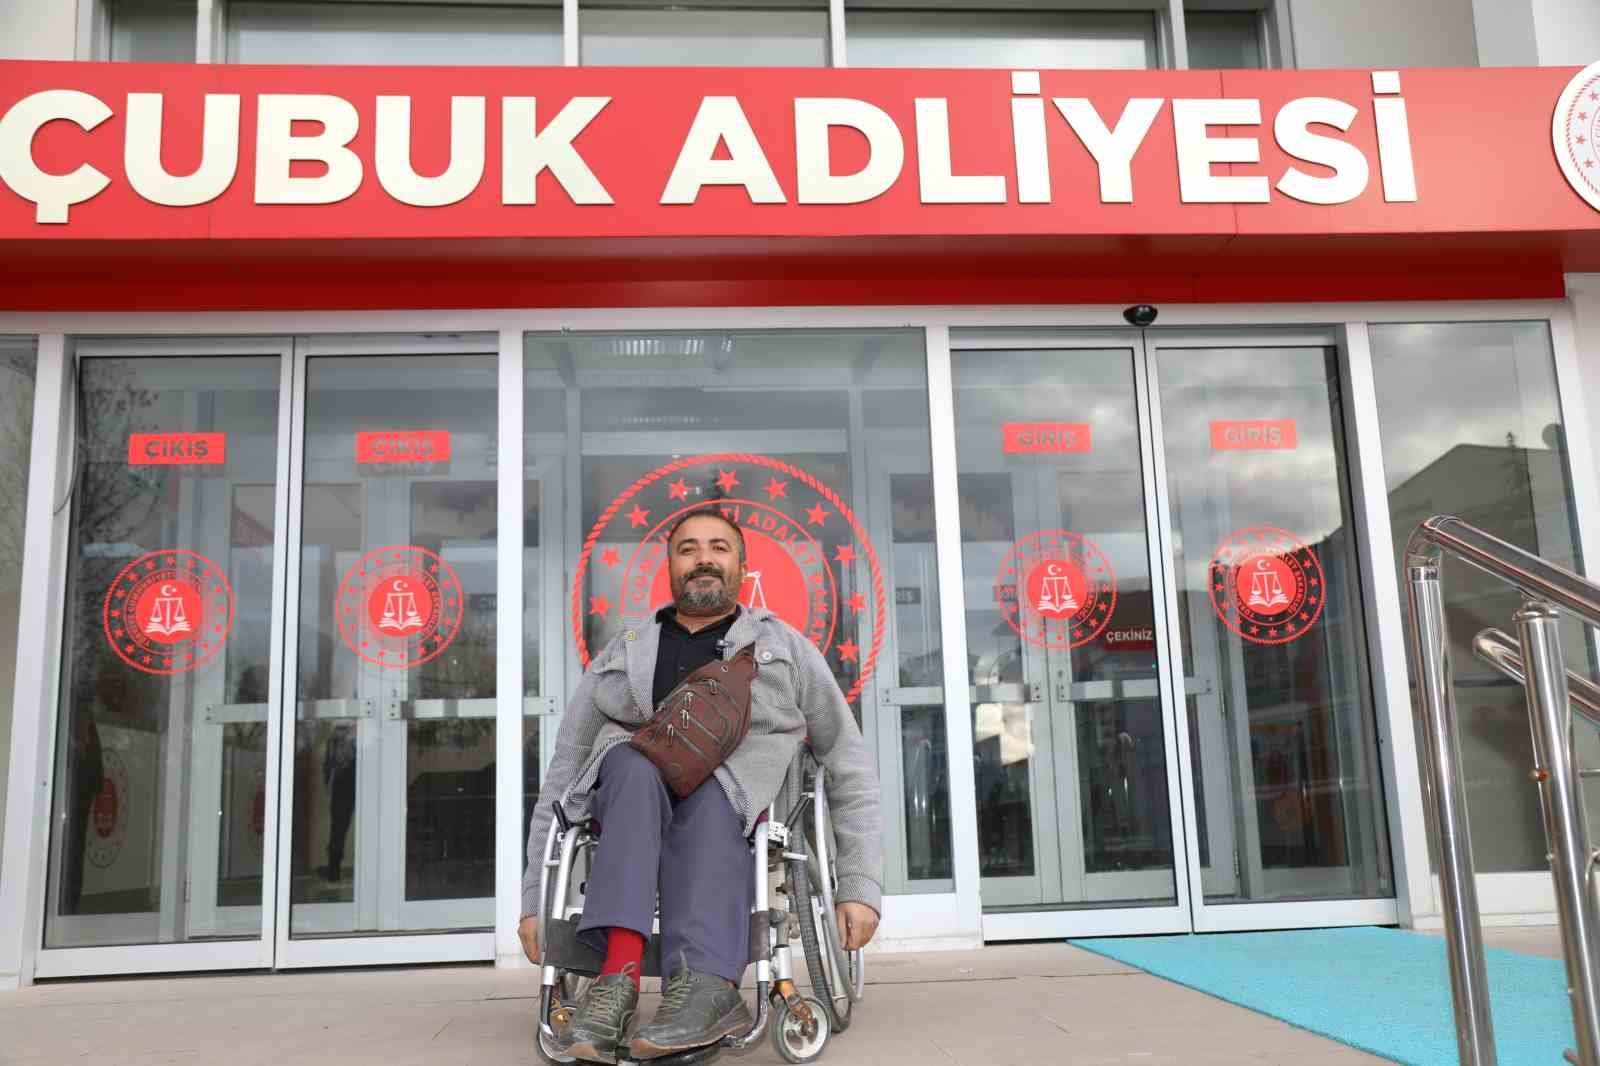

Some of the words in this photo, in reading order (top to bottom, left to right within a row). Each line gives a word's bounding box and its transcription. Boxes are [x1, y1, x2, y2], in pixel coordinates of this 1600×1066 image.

[0, 89, 614, 223] ÇUBUK
[660, 71, 1418, 204] ADLİYESİ
[1106, 627, 1153, 644] ÇEKİNİZ
